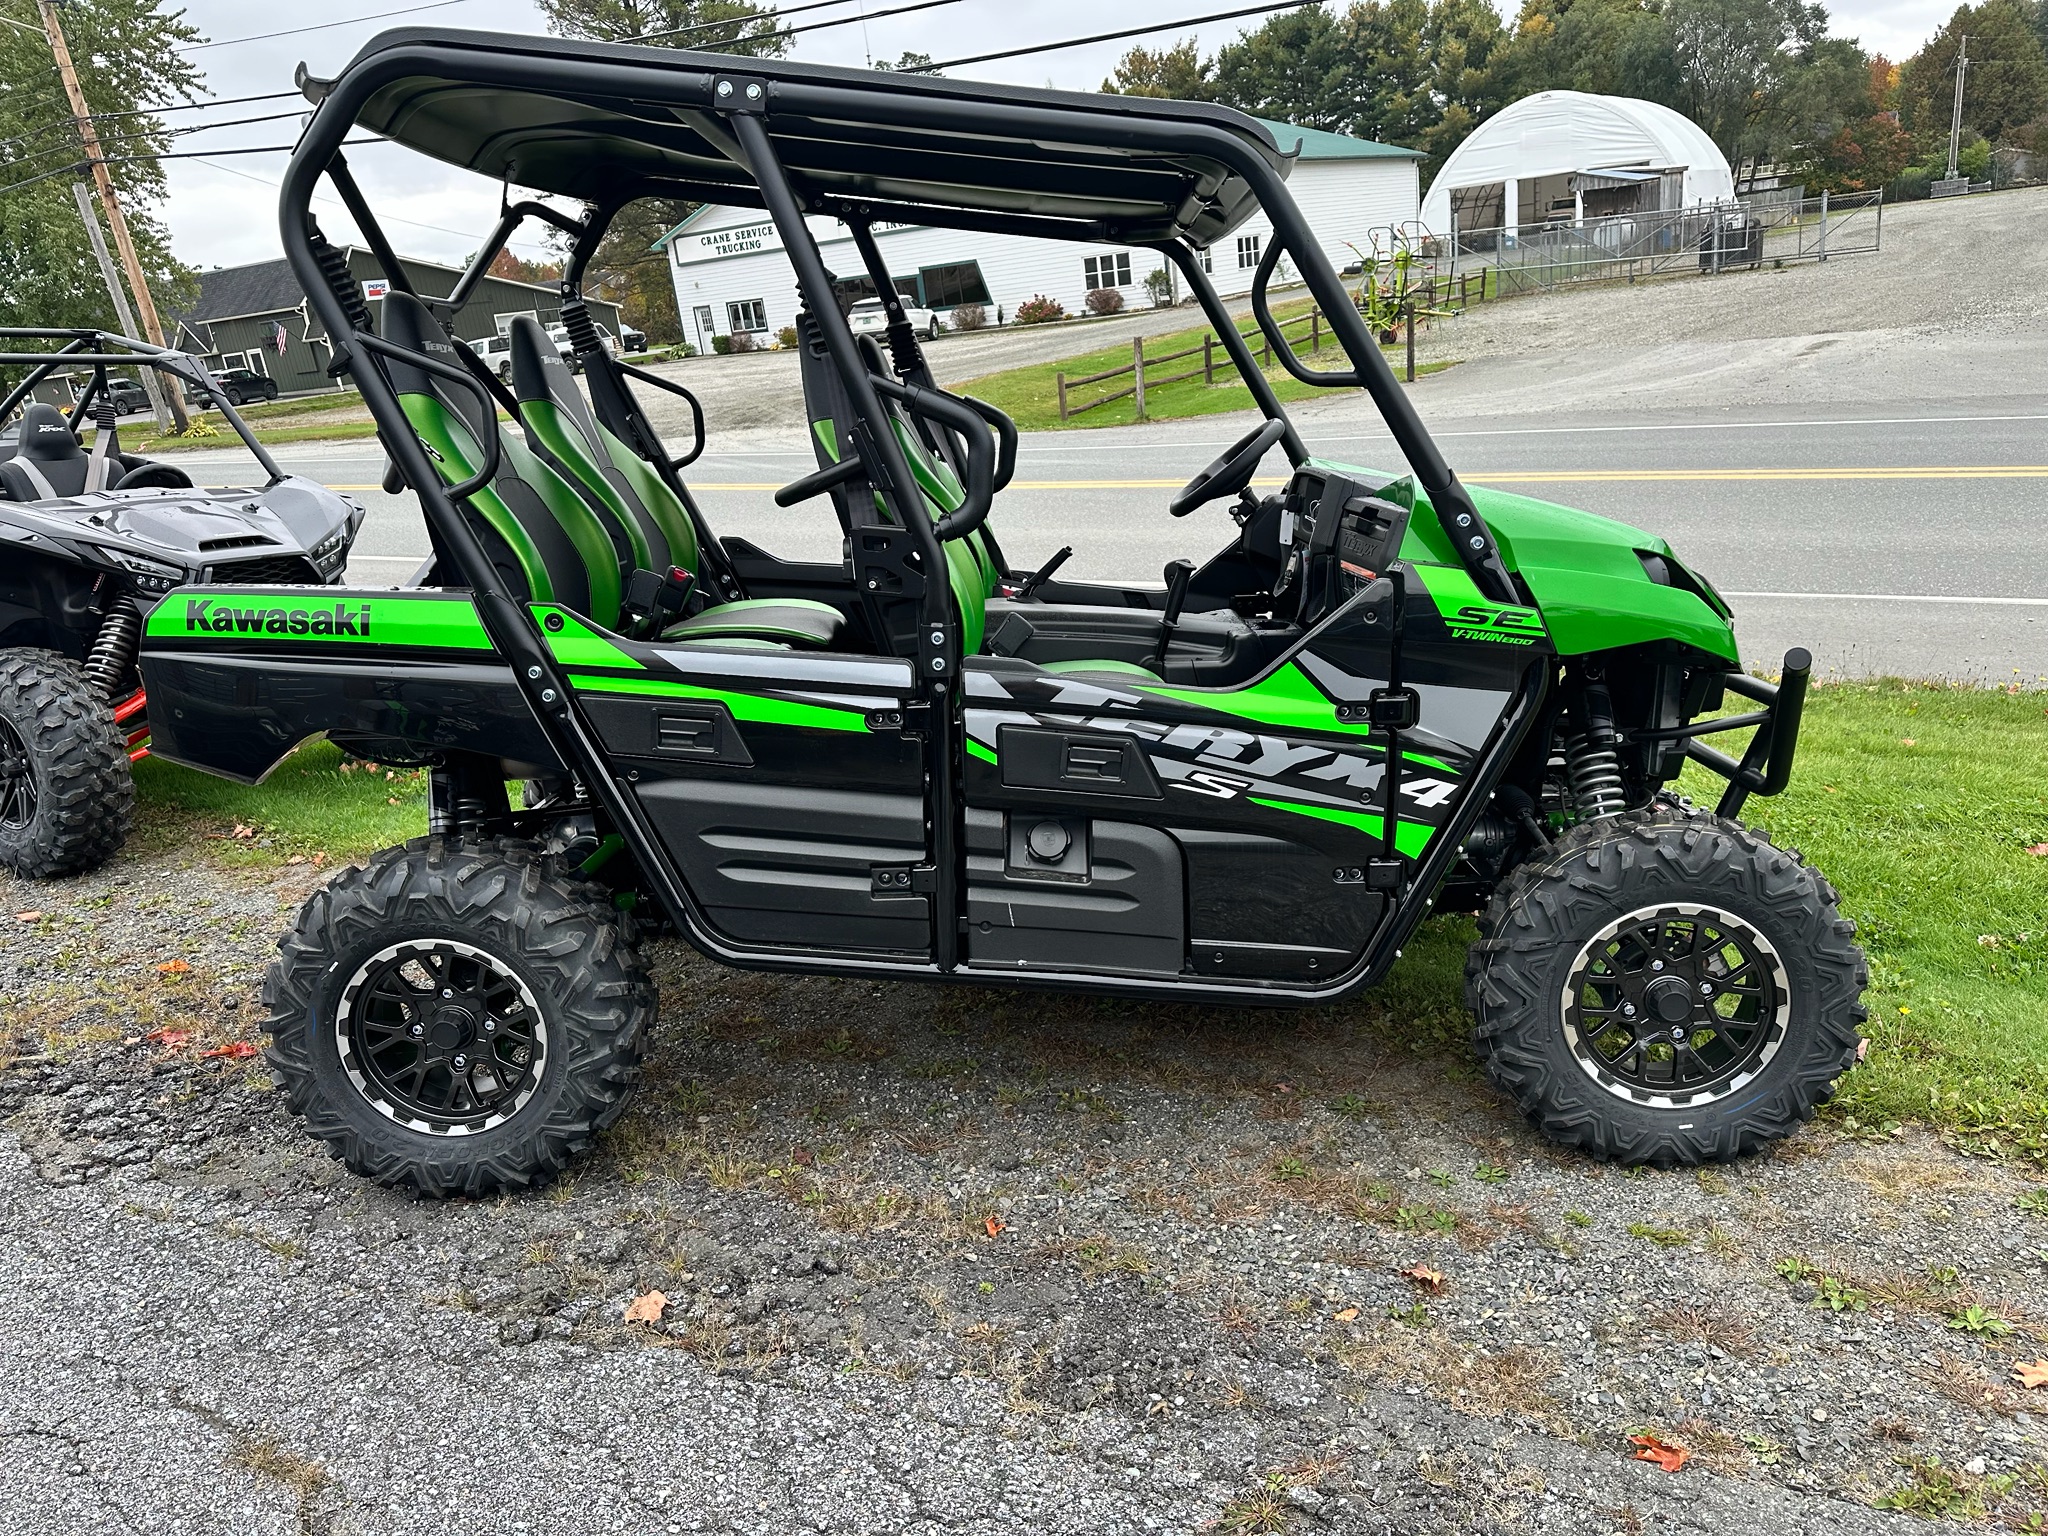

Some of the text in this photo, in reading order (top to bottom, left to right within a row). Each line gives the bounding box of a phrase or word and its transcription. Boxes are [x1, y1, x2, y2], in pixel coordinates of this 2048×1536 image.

[700, 226, 774, 246] CRANE SERVICE
[715, 240, 762, 255] TRUCKING
[186, 599, 371, 637] Kawasaki
[1442, 606, 1544, 630] SE
[1166, 772, 1249, 799] S
